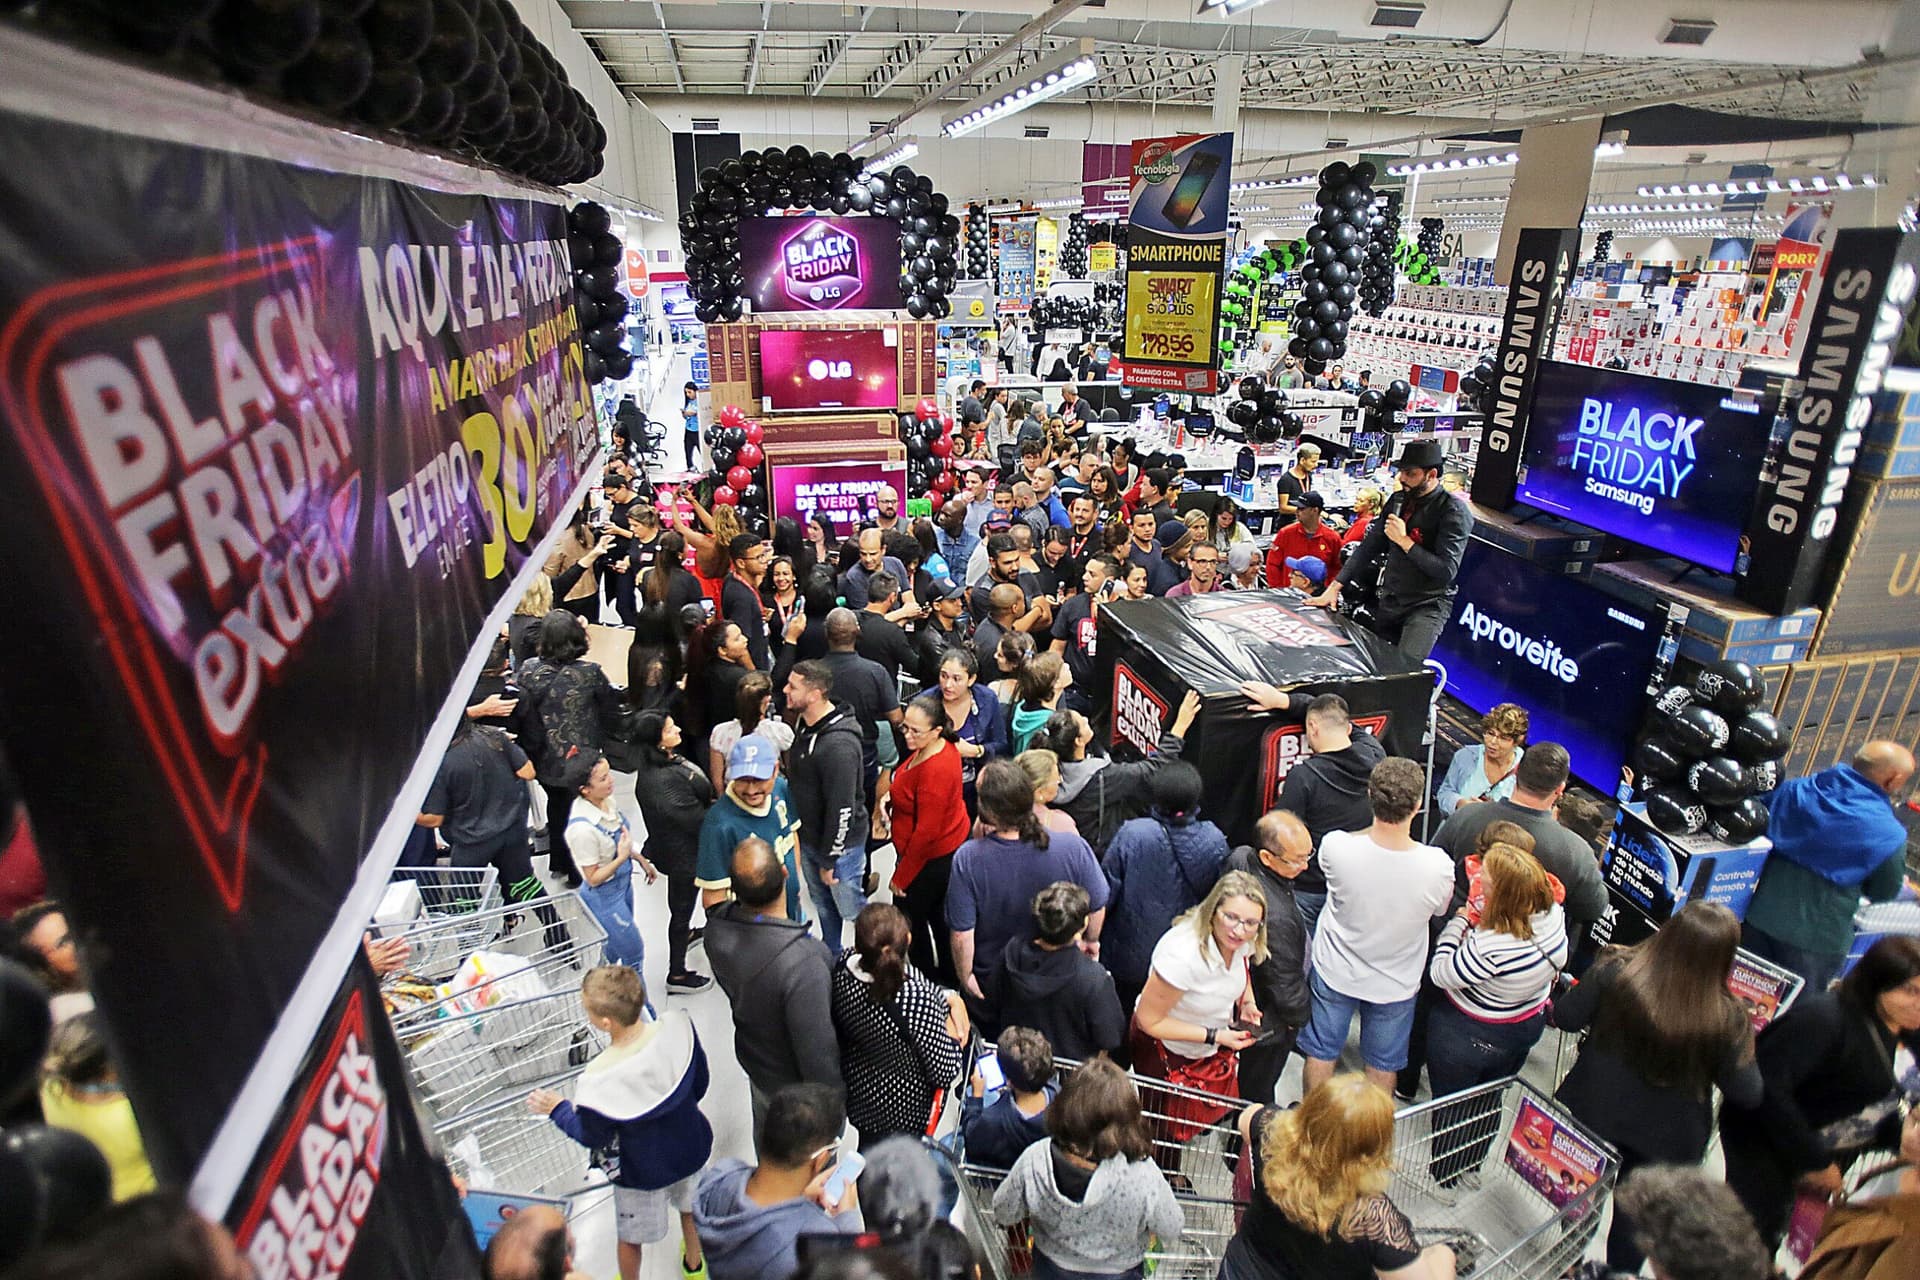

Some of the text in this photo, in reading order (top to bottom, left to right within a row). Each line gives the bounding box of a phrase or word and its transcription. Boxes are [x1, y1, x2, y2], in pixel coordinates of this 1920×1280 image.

[1133, 165, 1180, 176] Tecnologia
[787, 235, 852, 266] BLACK
[791, 252, 853, 281] FRIDAY
[1130, 244, 1222, 263] SMARTPHONE
[1147, 278, 1196, 295] SMART
[1552, 250, 1570, 300] 4K
[358, 243, 461, 362] AQUI
[481, 244, 521, 321] DE
[824, 287, 841, 298] LG
[1151, 291, 1188, 303] PHONE
[828, 360, 852, 378] LG
[1132, 368, 1161, 377] PAGANDO
[1489, 259, 1546, 453] SAMSUNG
[60, 284, 334, 508] BLACK
[1162, 378, 1182, 386] EXTRA
[1767, 267, 1872, 536] SAMSUNG
[1810, 262, 1917, 541] SAMSUNG
[1302, 414, 1318, 424] tra
[1578, 397, 1705, 460] BLACK
[1351, 440, 1385, 450] FRIDAY
[1571, 437, 1695, 499] FRIDAY
[116, 374, 352, 636] FRIDAY
[388, 440, 471, 569] ELETRO
[795, 480, 887, 497] BLACK FRIDAY
[795, 493, 878, 511] DE VERDD
[1584, 477, 1655, 516] Samsung
[195, 521, 341, 736] extra
[1607, 607, 1646, 631] SAMSUNG
[1458, 602, 1579, 684] Aproveite
[1119, 672, 1161, 728] BLACK
[1117, 714, 1147, 754] extra
[1118, 697, 1162, 746] FRIDAY
[744, 745, 758, 762] P
[1612, 864, 1654, 899] no mundo
[1615, 855, 1642, 880] de TVs
[1617, 847, 1664, 885] em vendas
[1714, 870, 1755, 882] Controle
[1710, 882, 1746, 894] Remoto
[250, 1033, 372, 1280] BLACK
